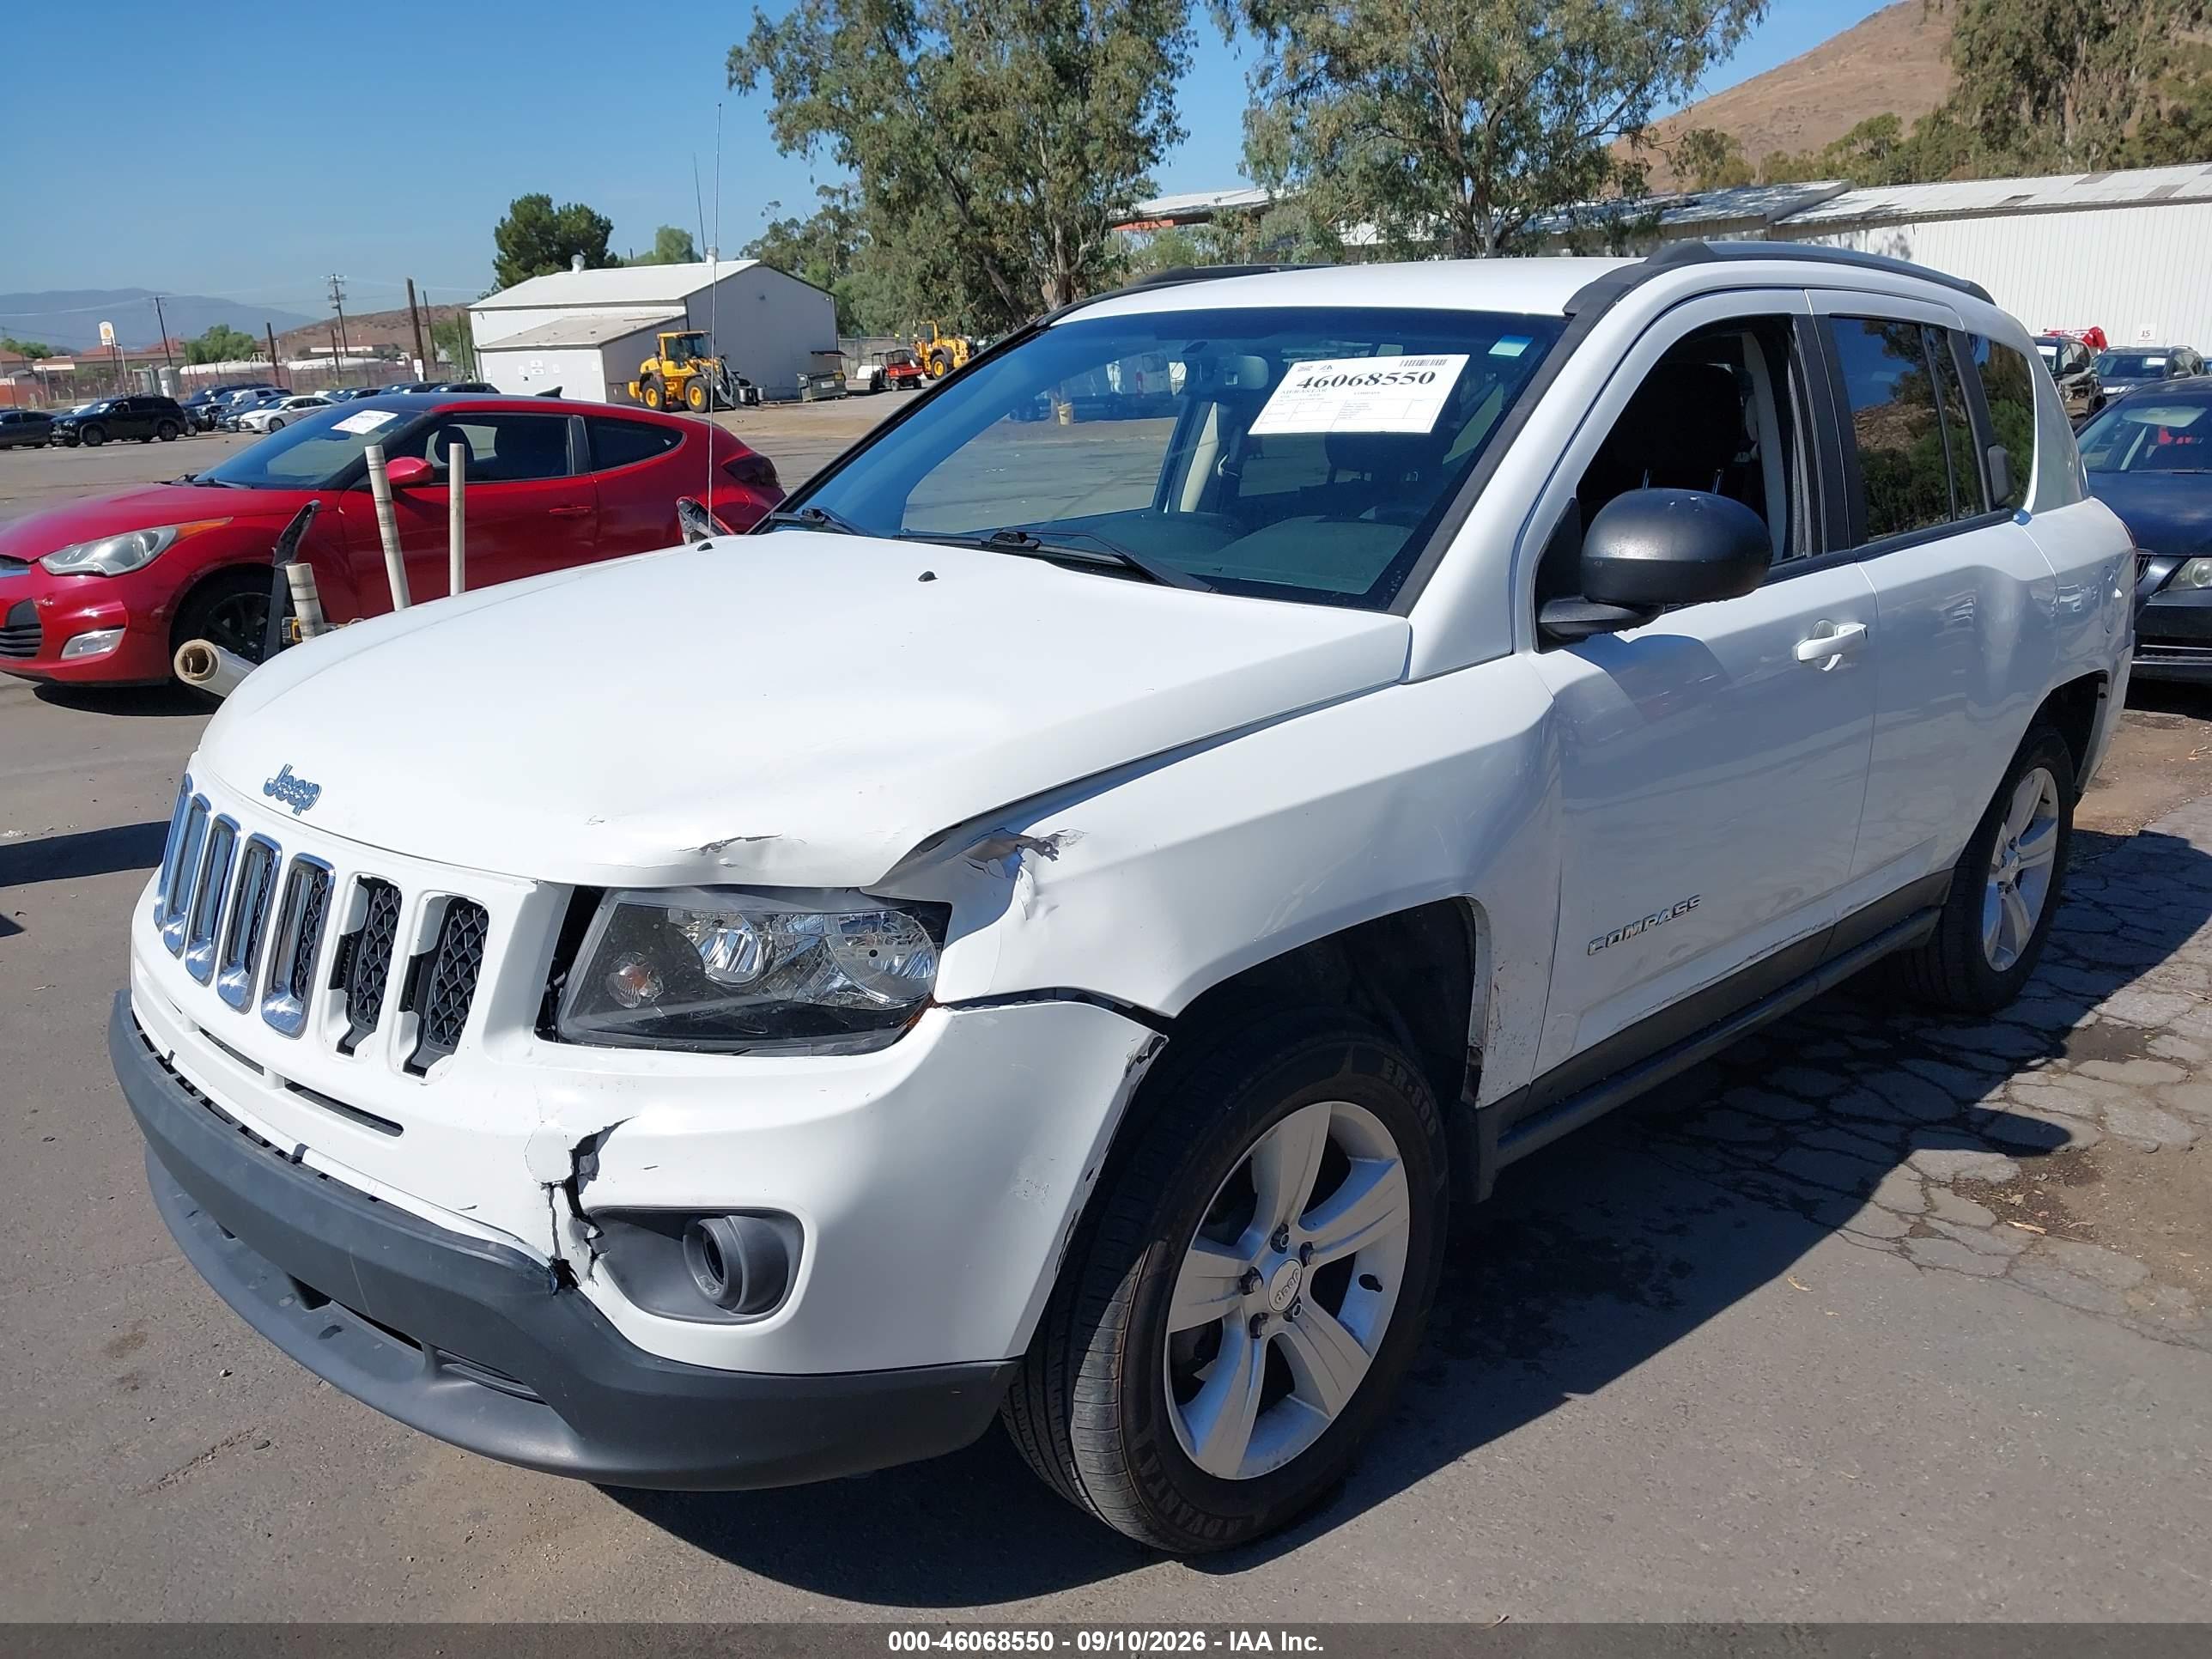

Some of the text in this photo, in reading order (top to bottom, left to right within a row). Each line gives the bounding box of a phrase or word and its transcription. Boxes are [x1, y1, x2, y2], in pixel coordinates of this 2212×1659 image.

[1297, 370, 1437, 389] 46068550
[263, 763, 322, 817] Jeep
[1587, 894, 1701, 956] COMPASS
[1274, 1267, 1299, 1304] Jeep
